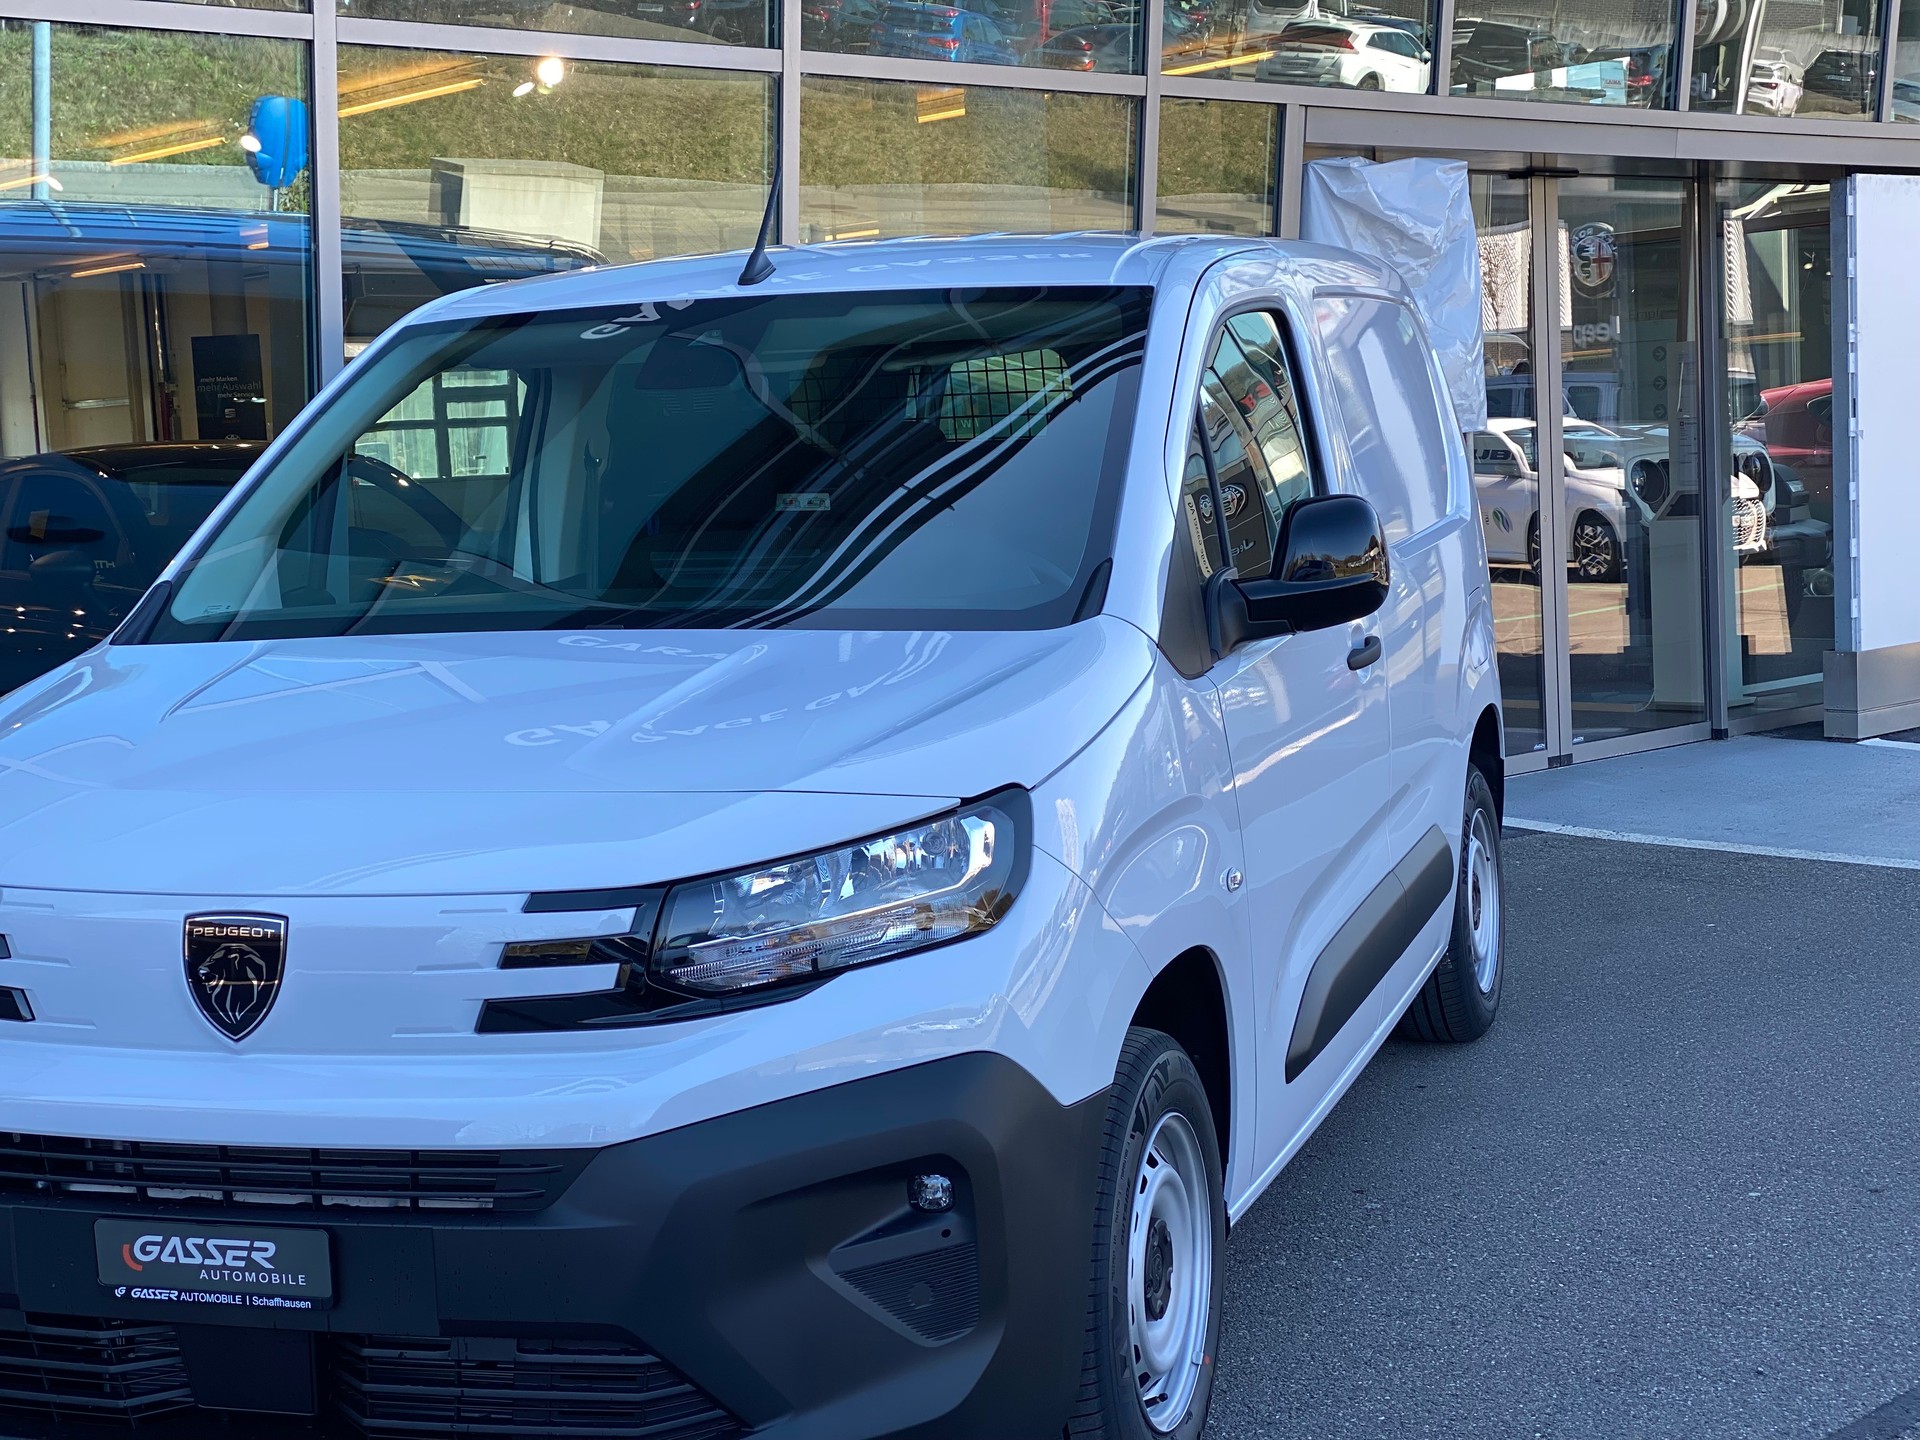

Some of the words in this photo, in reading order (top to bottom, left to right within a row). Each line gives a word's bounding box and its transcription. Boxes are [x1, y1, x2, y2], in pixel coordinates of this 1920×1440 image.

[197, 383, 219, 392] mehr
[222, 381, 261, 391] Auswahl
[193, 926, 276, 939] PEUGEOT
[133, 1235, 276, 1269] GASSER
[199, 1269, 307, 1286] AUTOMOBILE
[131, 1287, 179, 1301] GASSER
[180, 1292, 243, 1305] AUTOMOBILE
[252, 1296, 312, 1309] Schaffhausen
